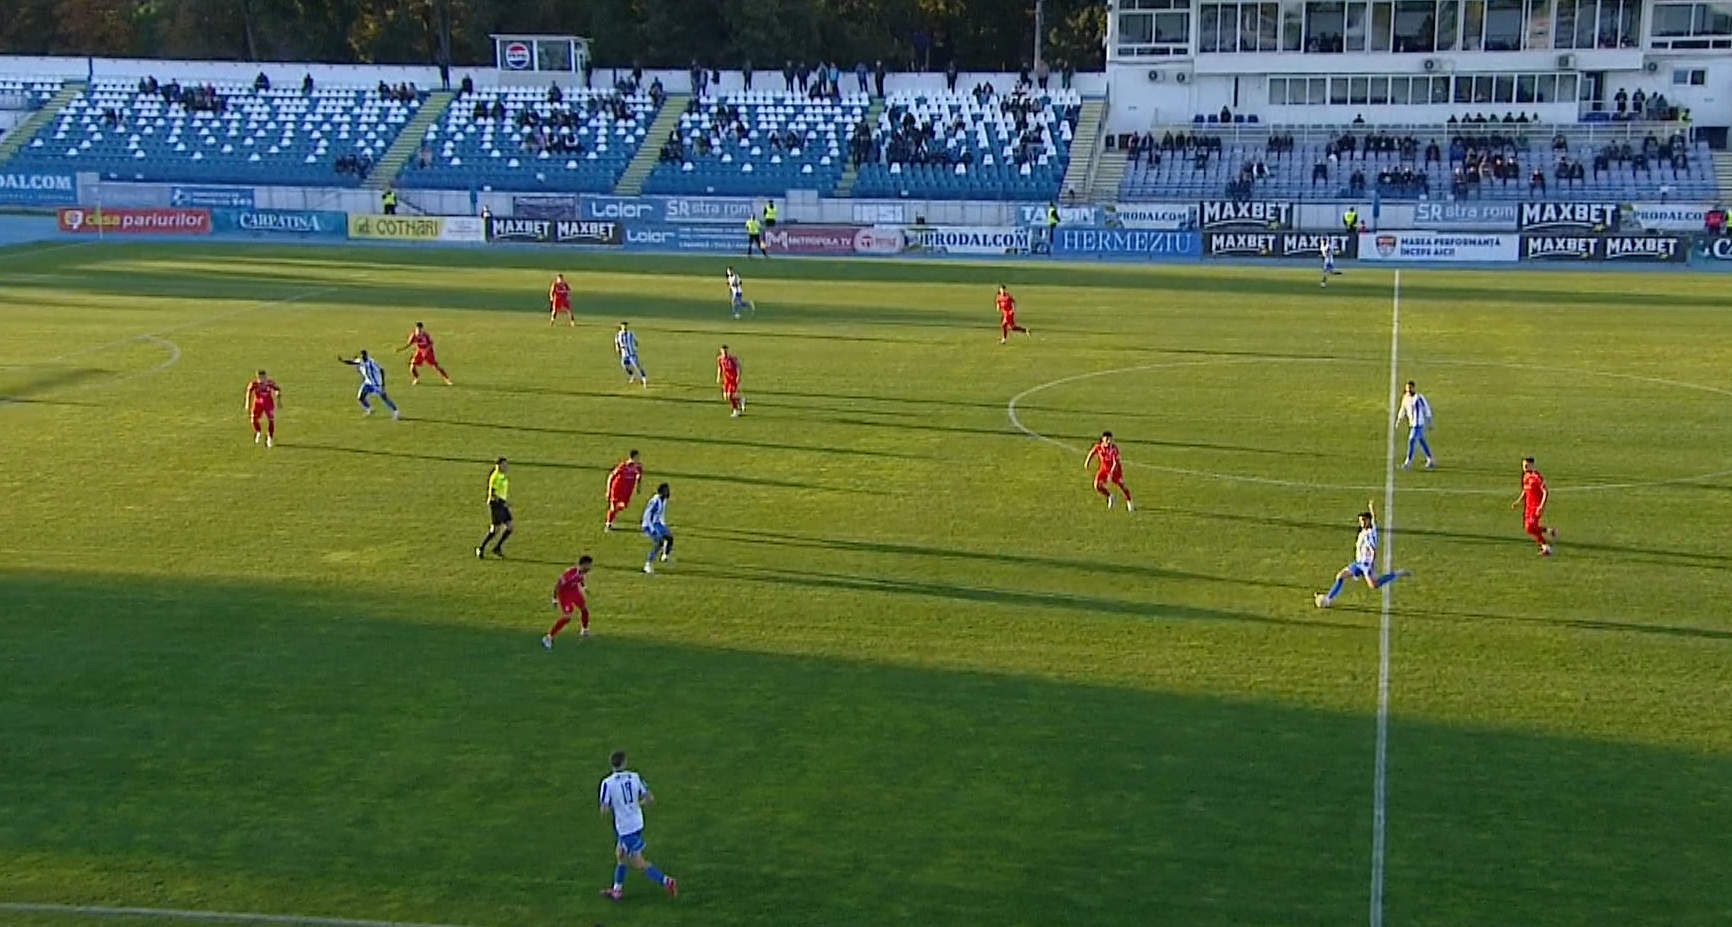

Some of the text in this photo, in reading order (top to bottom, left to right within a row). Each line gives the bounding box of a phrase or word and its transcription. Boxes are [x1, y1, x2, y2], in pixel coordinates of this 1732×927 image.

[239, 213, 321, 231] CARPATINA
[1117, 211, 1187, 221] PRODALCOM
[1203, 202, 1290, 223] MAXBET
[1522, 204, 1616, 226] MAXBET
[1634, 211, 1702, 221] PRODALCO
[493, 220, 550, 240] MAXBET
[557, 221, 615, 240] MAXBET
[924, 232, 1029, 247] PRODALCOM
[1063, 230, 1191, 253] HERMEZIU
[1211, 234, 1275, 253] MAXBET
[1528, 237, 1677, 258] MAXBET MAXBET
